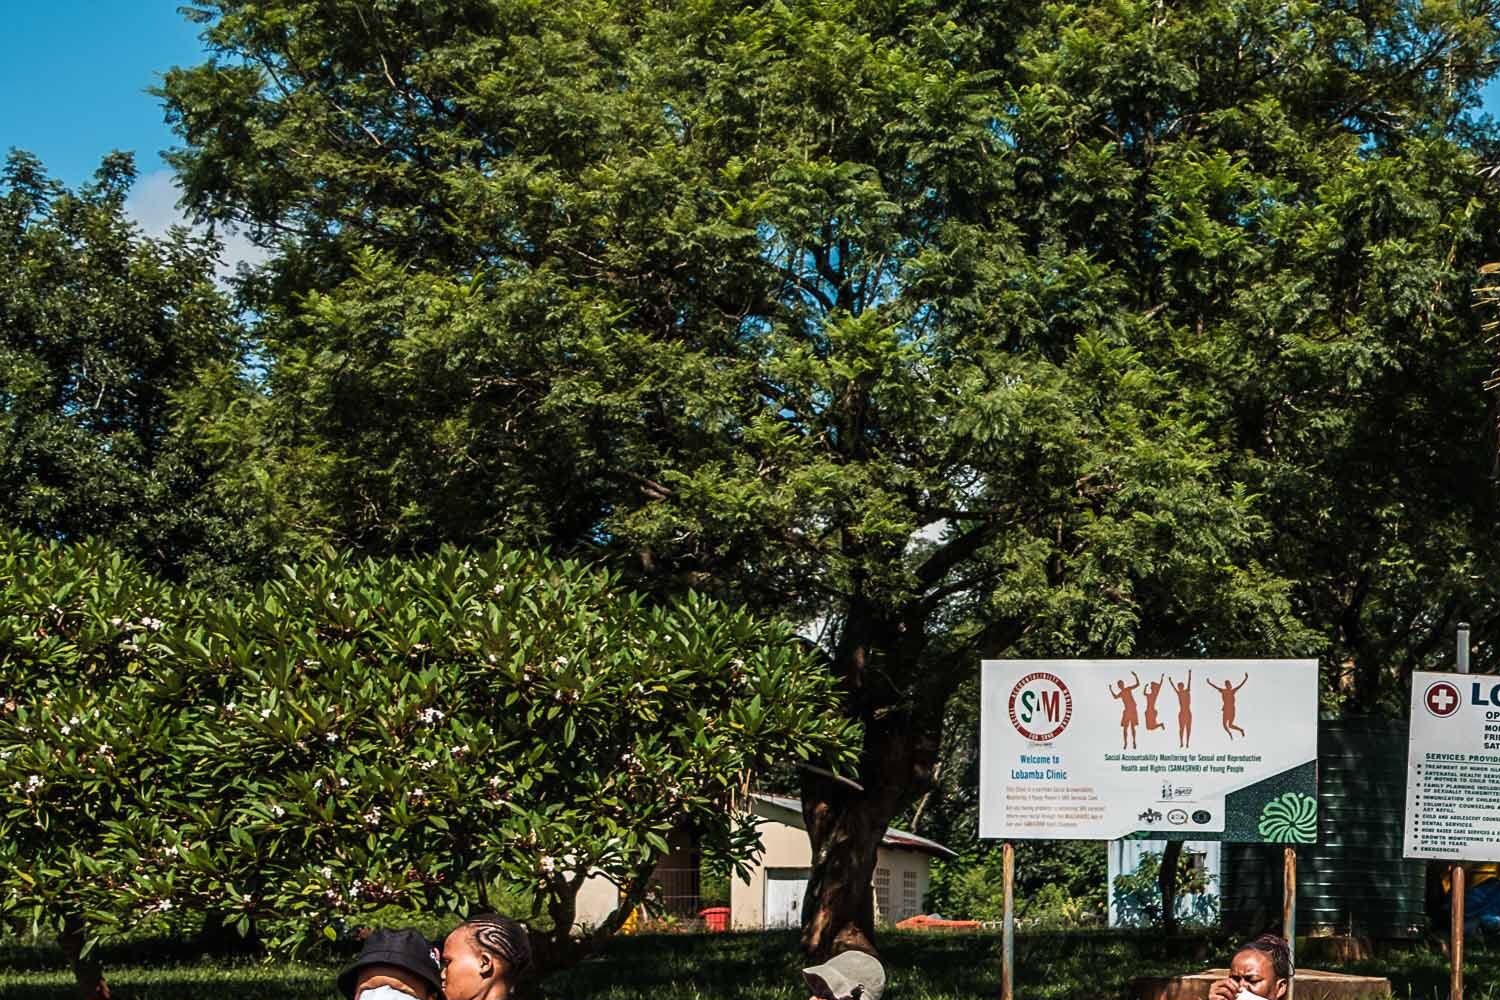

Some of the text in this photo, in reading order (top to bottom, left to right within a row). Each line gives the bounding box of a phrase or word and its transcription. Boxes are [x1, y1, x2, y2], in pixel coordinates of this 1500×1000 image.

[1020, 754, 1059, 763] Welcome to
[1159, 754, 1187, 762] Monitoring
[1227, 754, 1261, 762] Reproductive
[1425, 752, 1465, 761] SERVICES
[1149, 764, 1166, 772] Rights
[1209, 765, 1225, 773] Young
[1011, 769, 1067, 779] Lobamba Clinic
